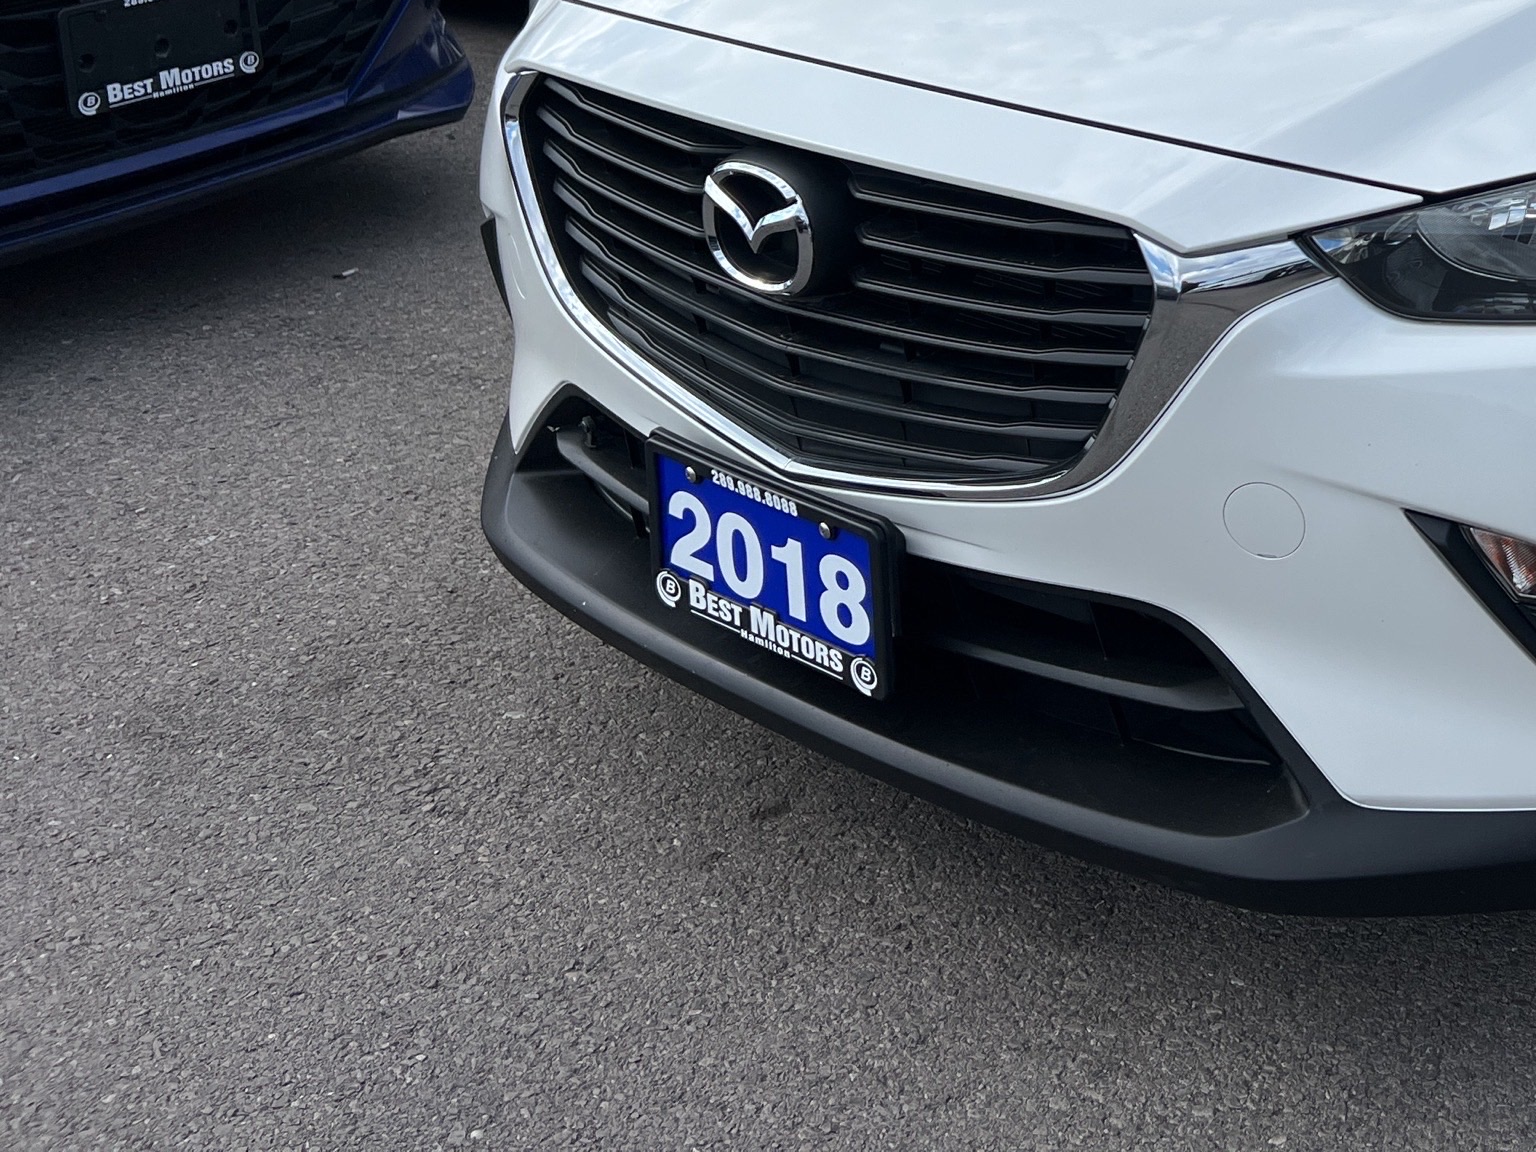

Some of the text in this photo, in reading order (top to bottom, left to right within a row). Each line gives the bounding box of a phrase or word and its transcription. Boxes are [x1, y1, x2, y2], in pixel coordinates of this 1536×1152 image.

[106, 58, 235, 104] BEST MOTORS
[710, 469, 799, 518] 289.988.8088
[668, 490, 871, 646] 2018
[688, 578, 845, 673] BEST MOTORS
[739, 629, 791, 659] Hamilton
